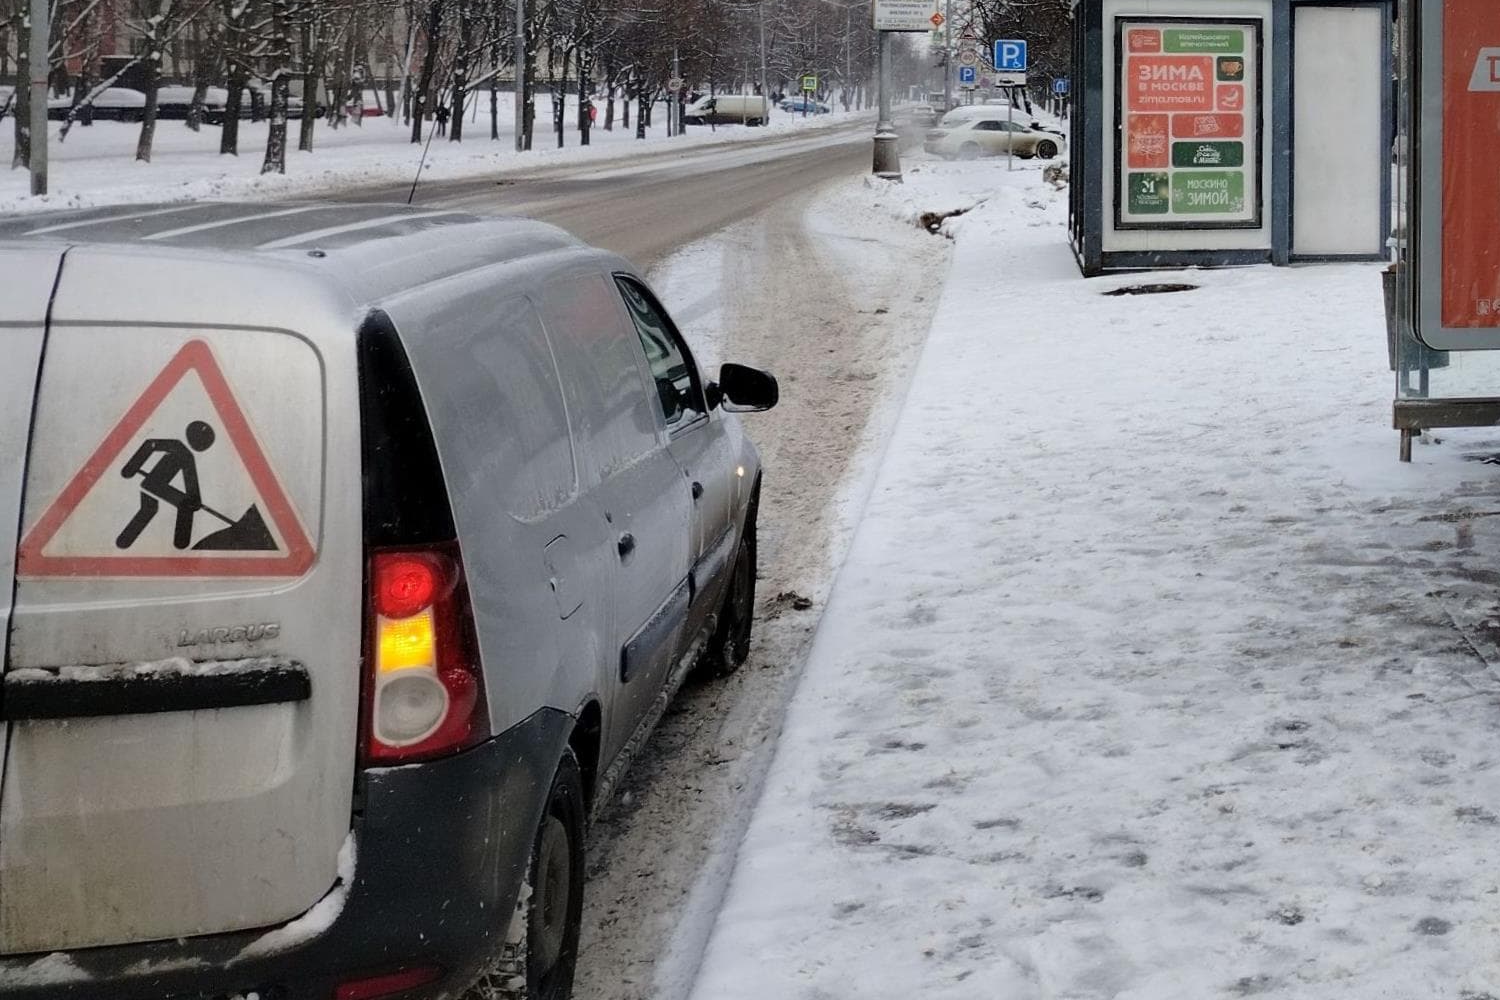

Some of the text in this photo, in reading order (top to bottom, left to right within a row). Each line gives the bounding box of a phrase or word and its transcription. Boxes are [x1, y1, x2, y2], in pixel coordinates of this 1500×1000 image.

[1003, 44, 1020, 67] P
[963, 68, 973, 81] P
[1138, 64, 1204, 81] ЗИМА
[1138, 82, 1205, 91] В МОСКВЕ
[1138, 93, 1205, 104] zima.mos.ru
[1187, 179, 1229, 189] МОСКИНО
[1187, 189, 1229, 206] ЗИМОЙ
[177, 623, 280, 647] LARGUS
